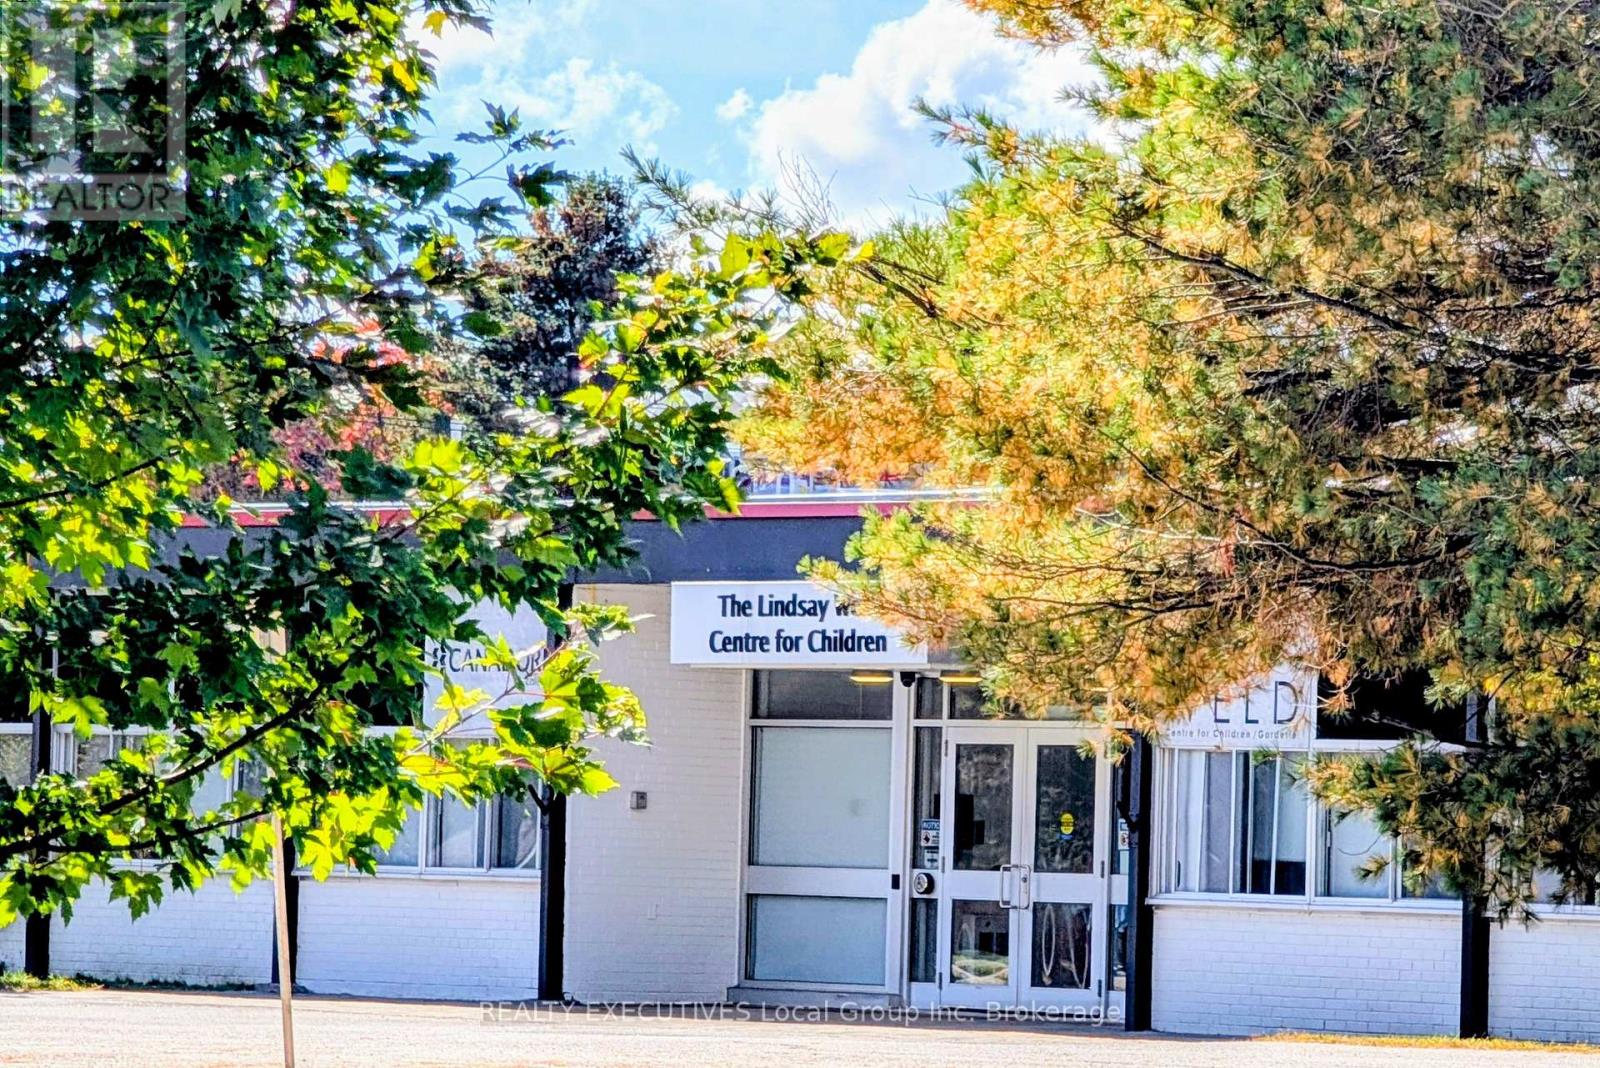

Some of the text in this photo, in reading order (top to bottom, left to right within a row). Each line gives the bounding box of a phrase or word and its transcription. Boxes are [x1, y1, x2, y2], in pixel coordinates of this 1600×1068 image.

[718, 594, 752, 617] The
[757, 593, 830, 622] Lindsay
[709, 629, 887, 653] Centre for Children
[1197, 728, 1209, 738] for
